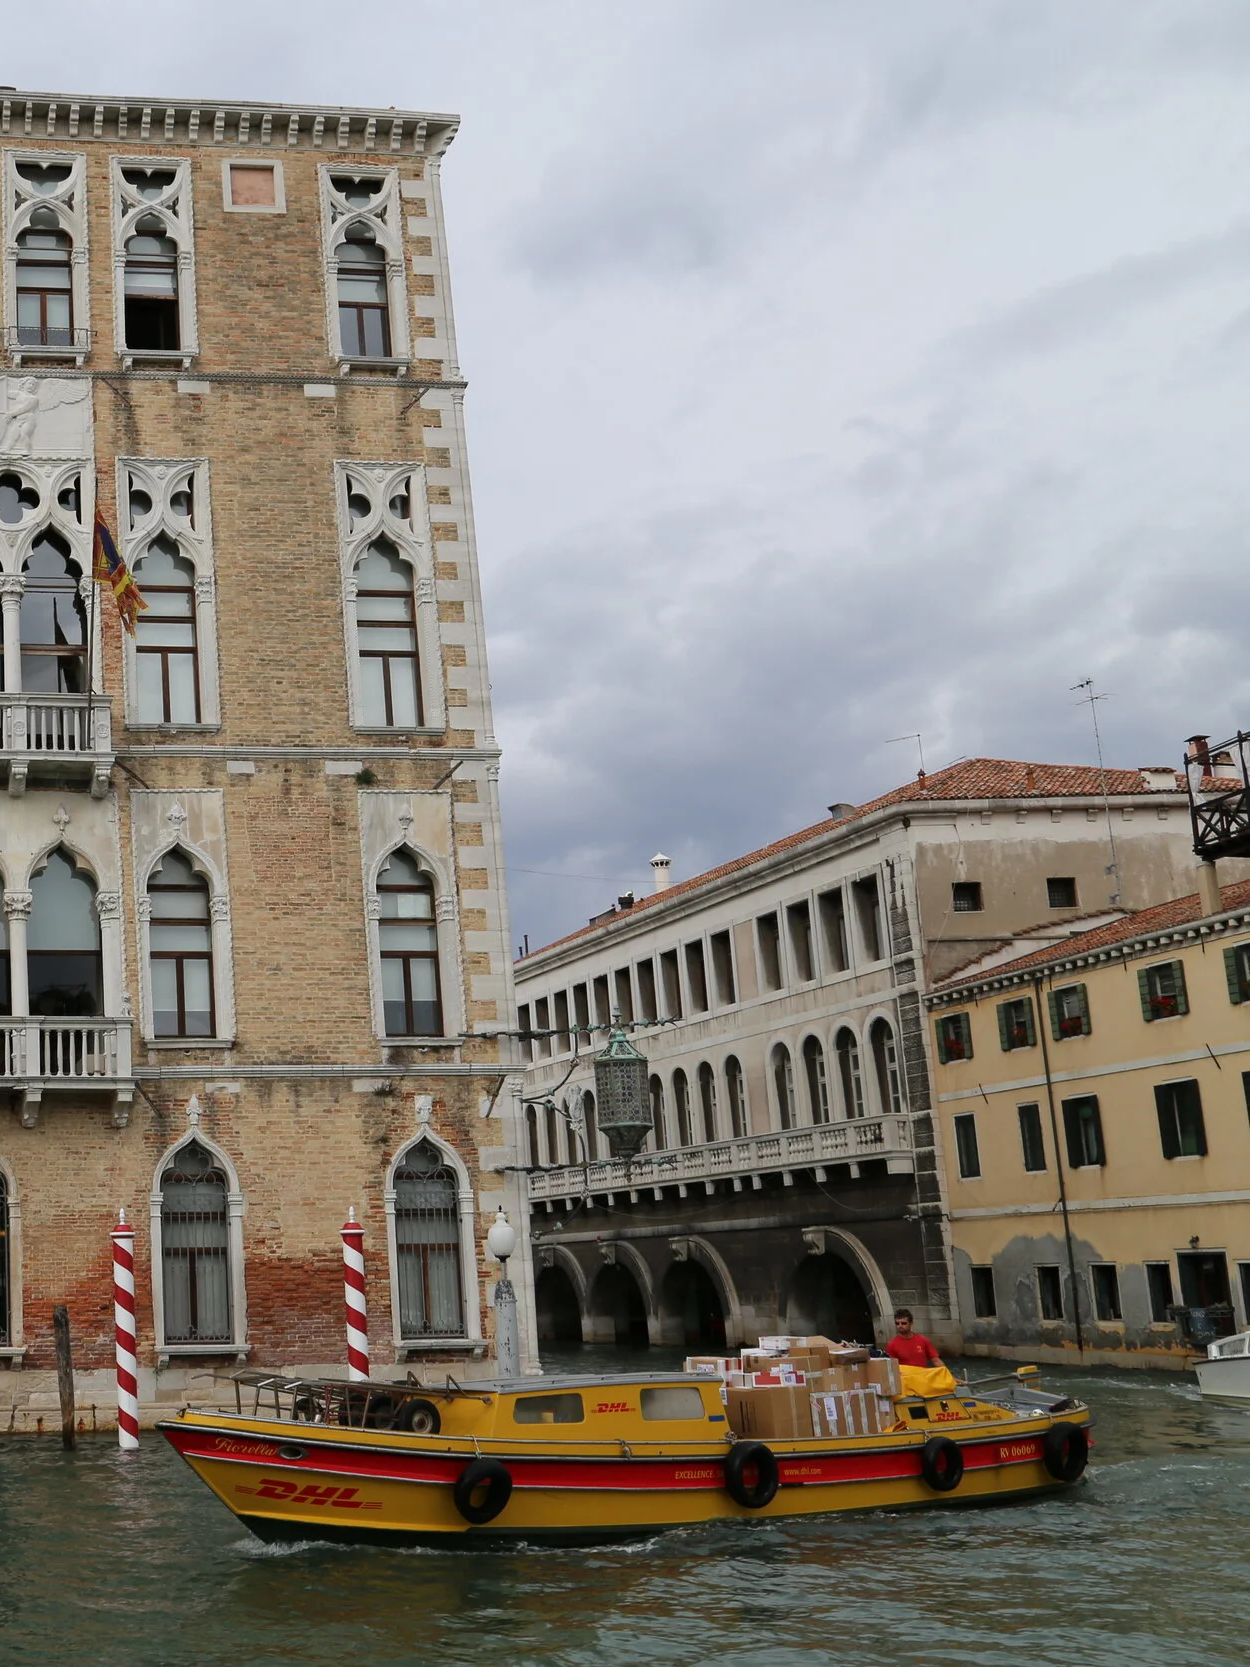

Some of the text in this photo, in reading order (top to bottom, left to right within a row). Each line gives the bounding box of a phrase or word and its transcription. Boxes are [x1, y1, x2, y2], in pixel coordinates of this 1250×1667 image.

[596, 1402, 631, 1413] DHL
[936, 1411, 963, 1421] DHL
[209, 1437, 277, 1457] Fiorella
[1000, 1444, 1036, 1459] RV 06069
[784, 1467, 822, 1477] www.dhl.com
[254, 1478, 366, 1509] DHL
